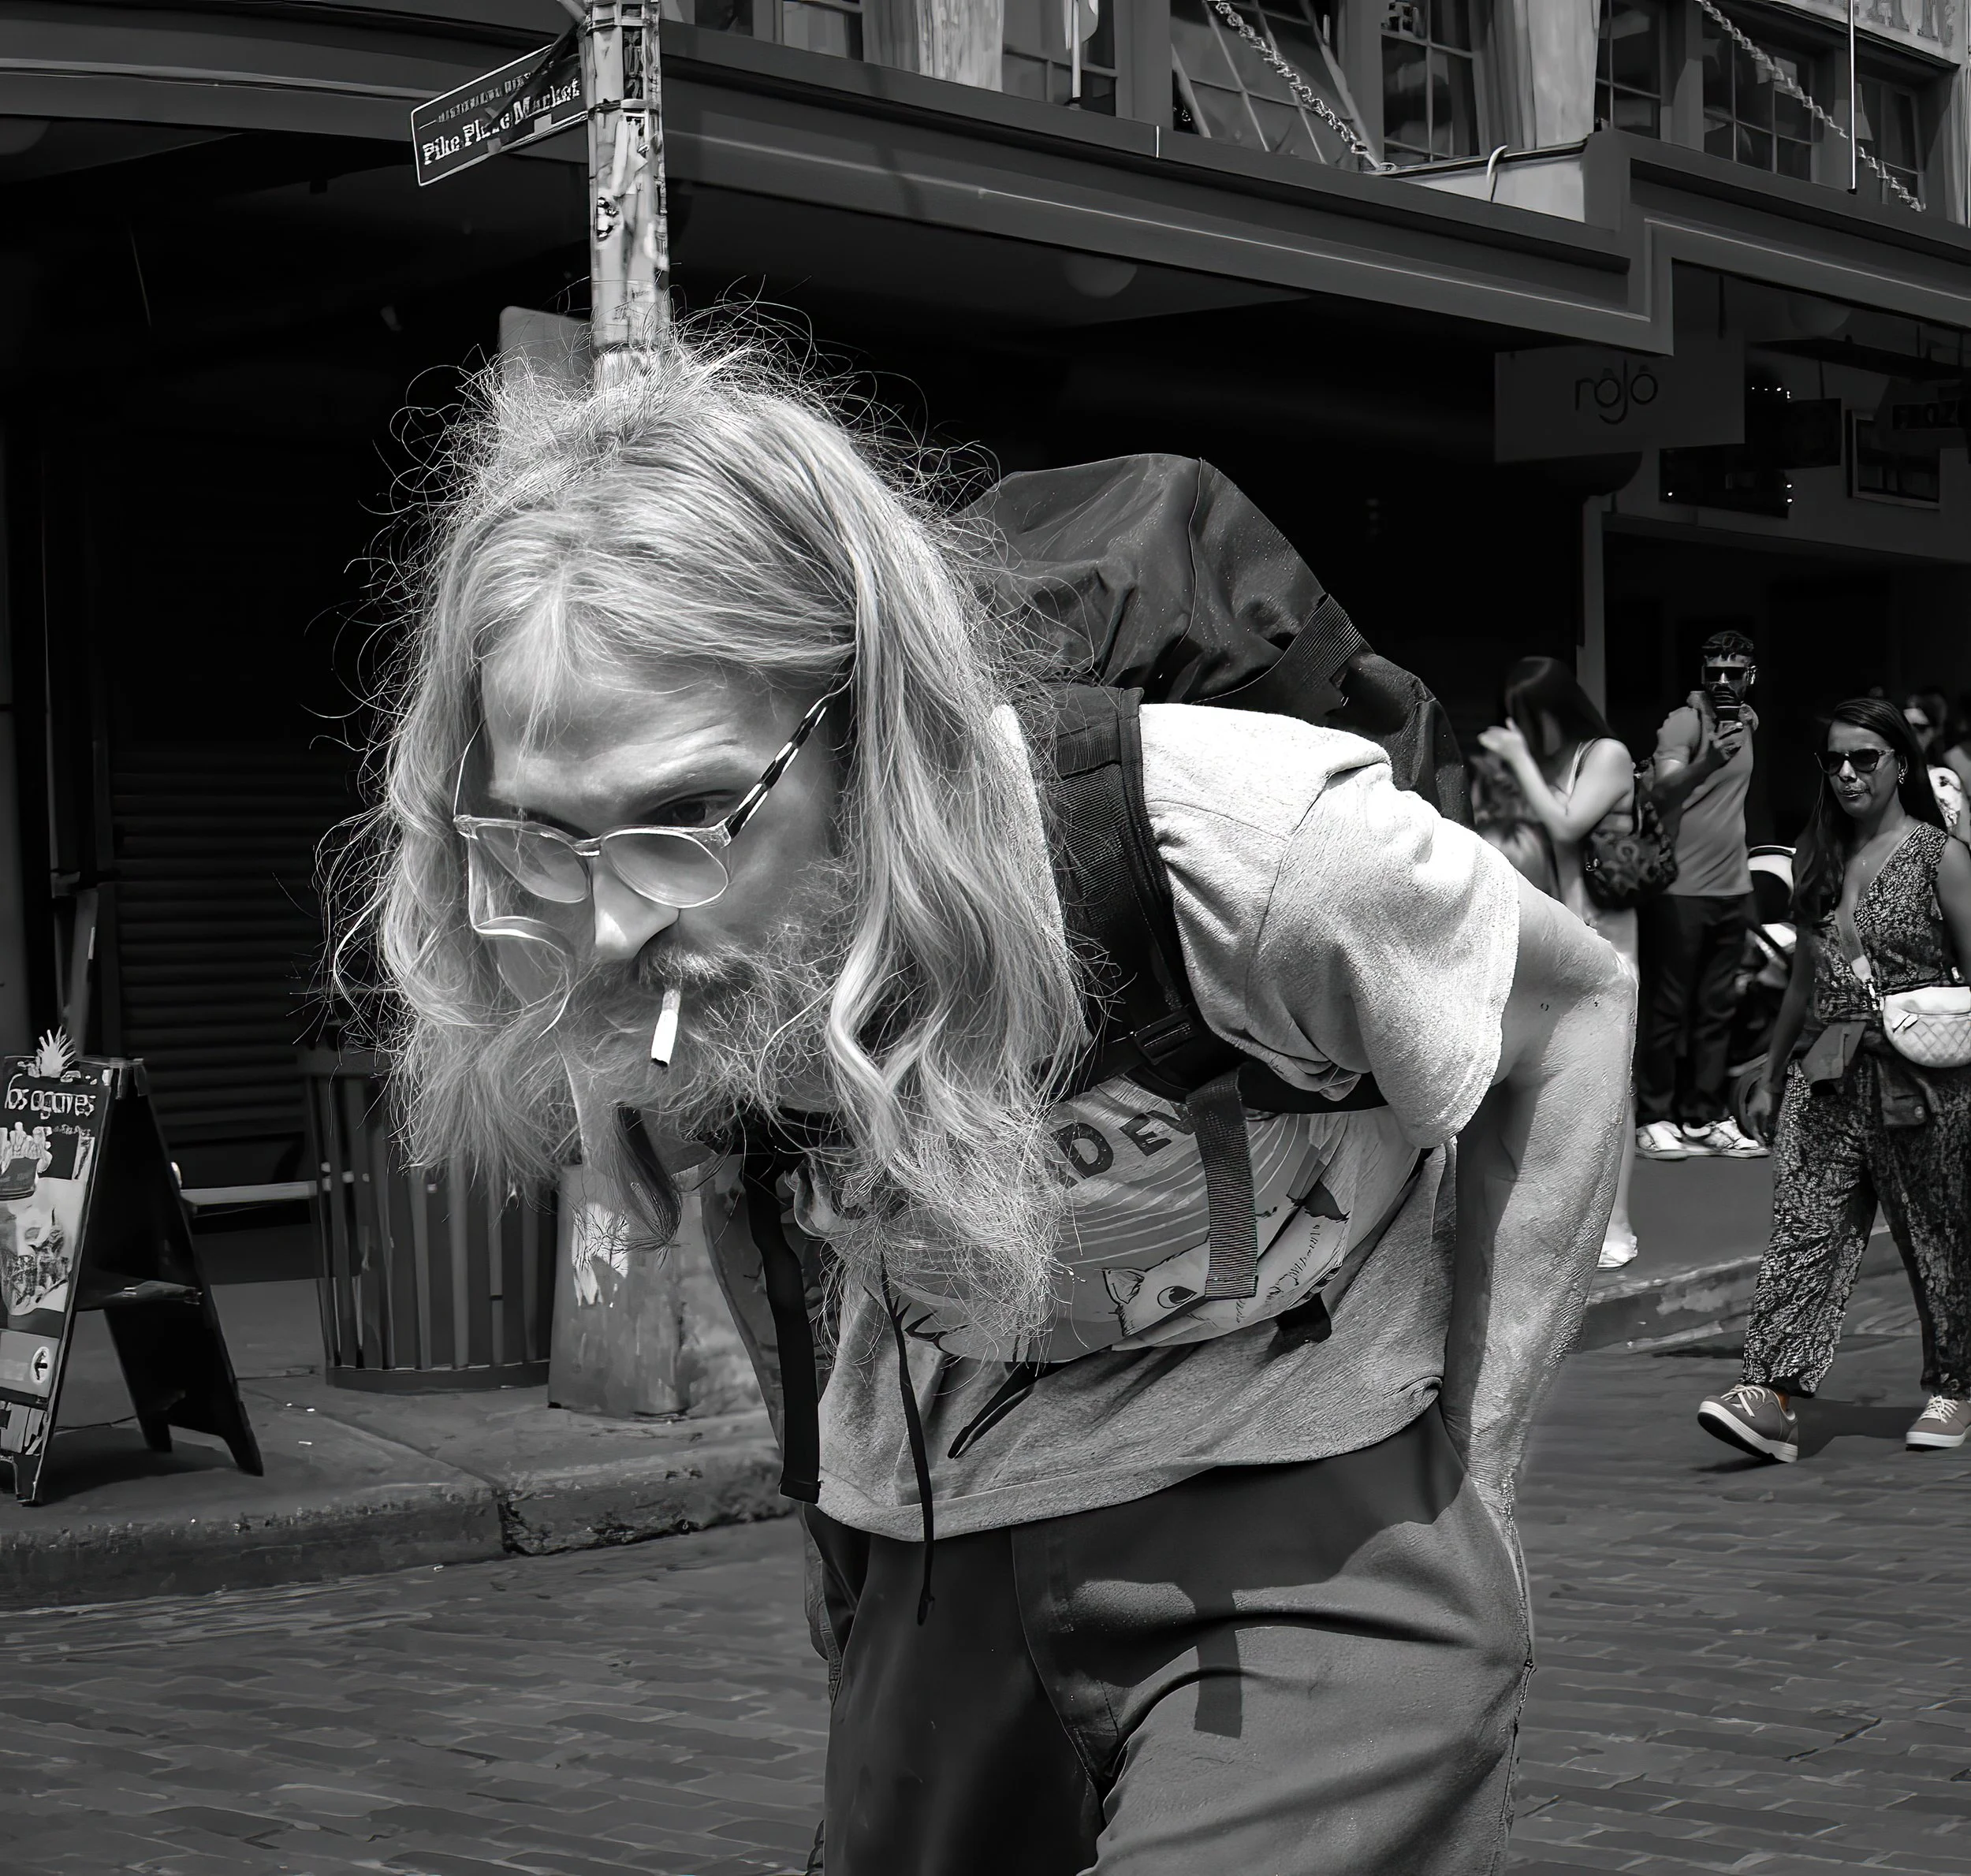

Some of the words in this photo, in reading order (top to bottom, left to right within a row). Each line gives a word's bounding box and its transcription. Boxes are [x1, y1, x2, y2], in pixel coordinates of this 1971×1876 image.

[422, 135, 461, 166] Pike
[462, 113, 510, 147] Ple
[1045, 1105, 1197, 1189] DEV
